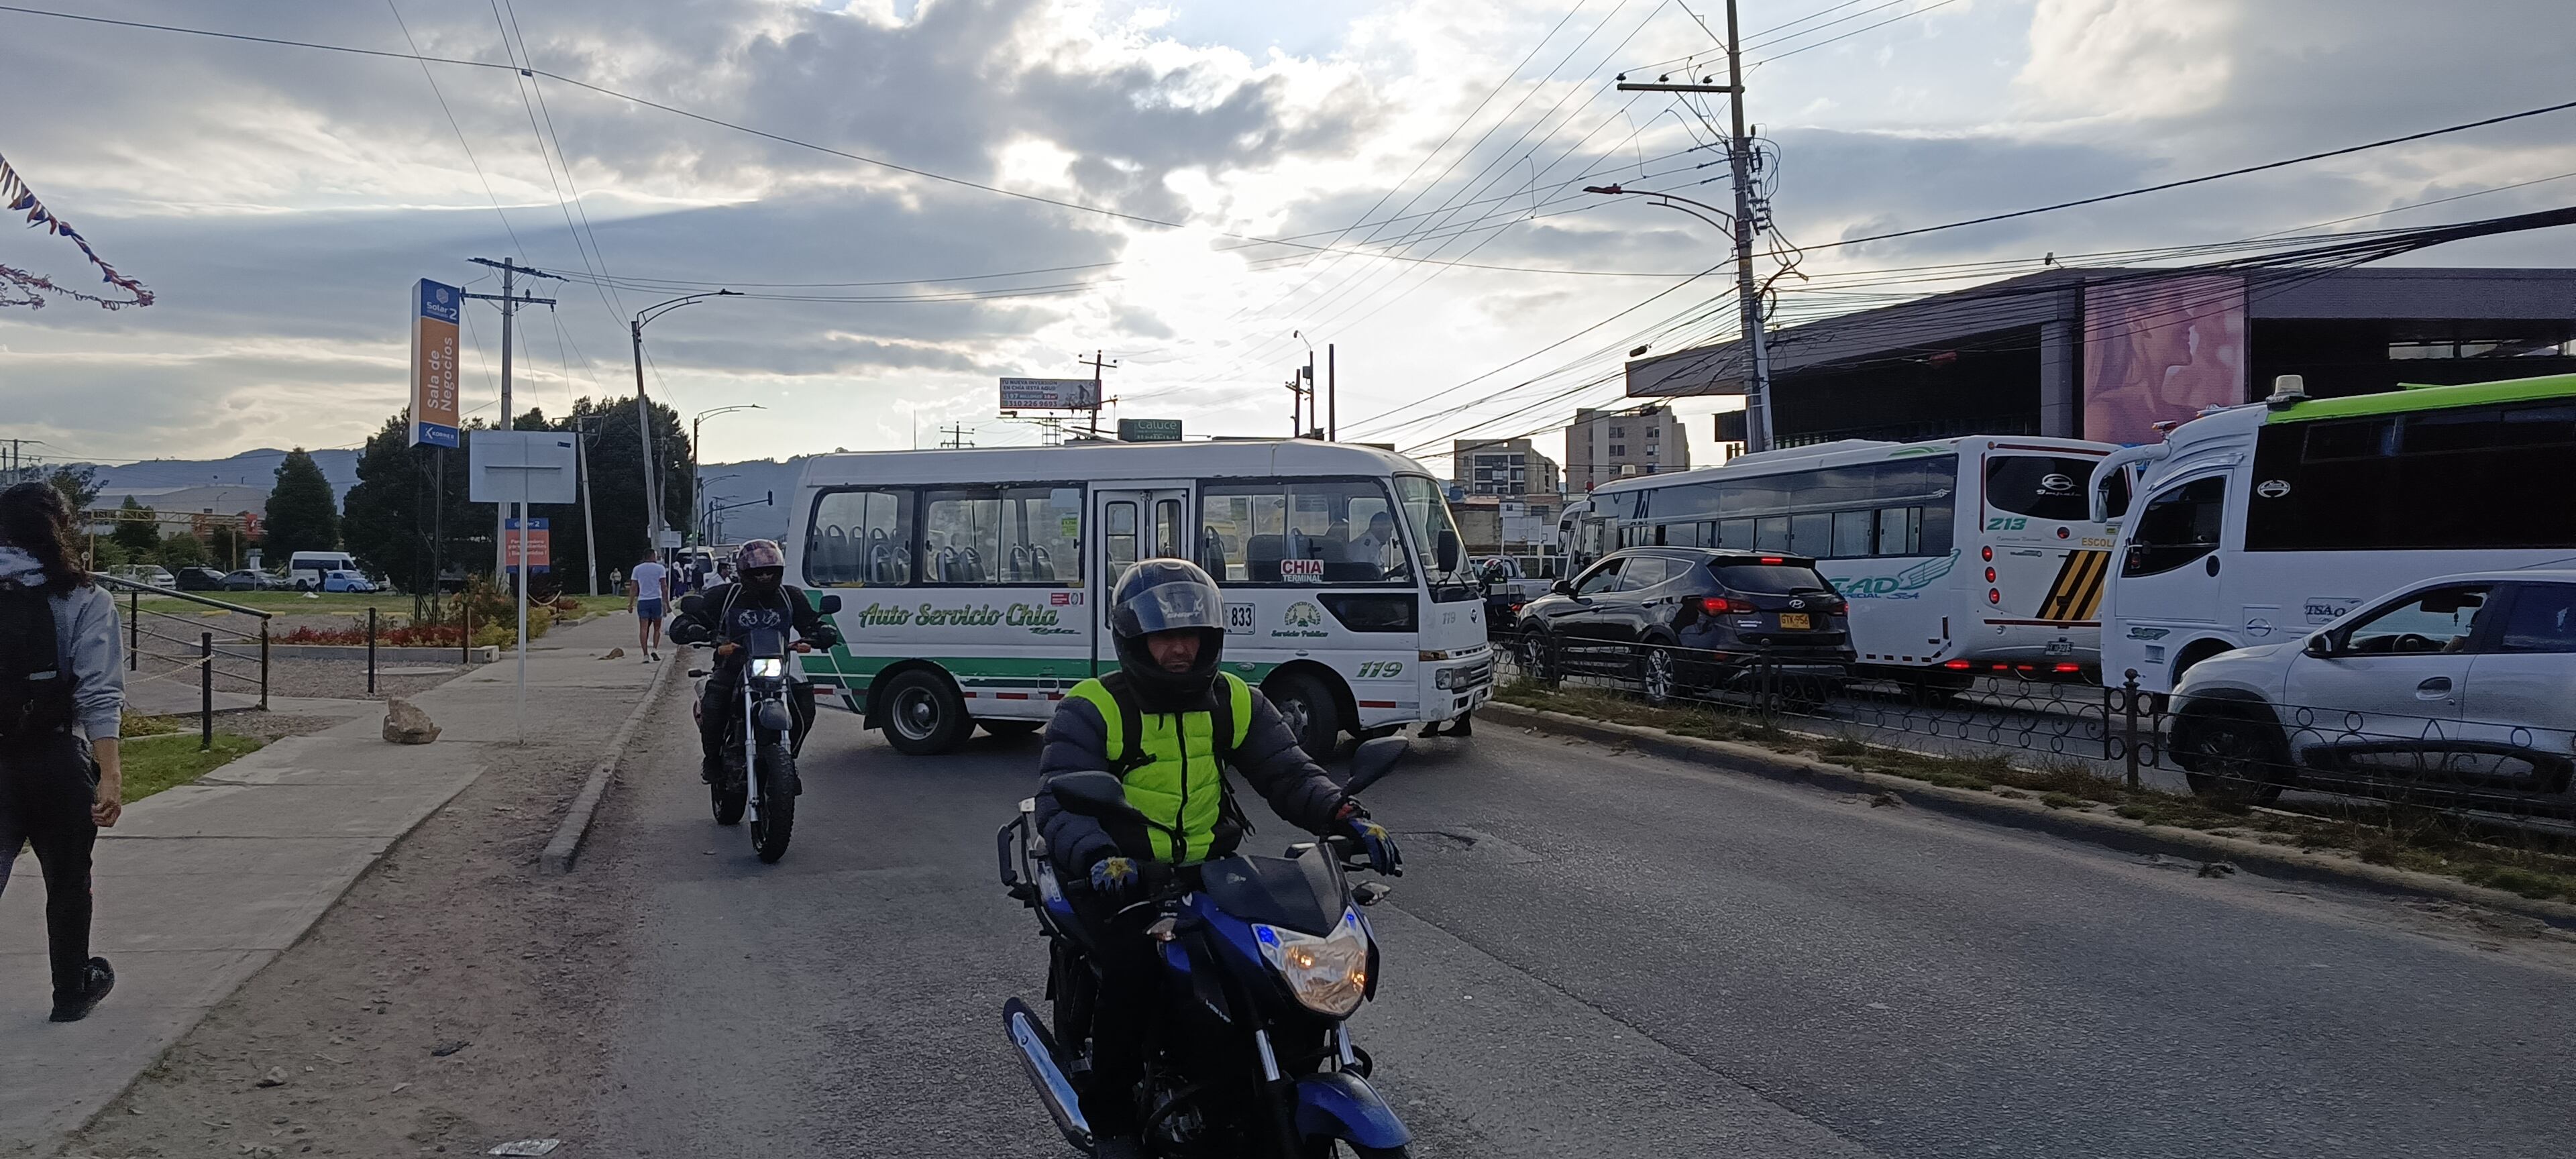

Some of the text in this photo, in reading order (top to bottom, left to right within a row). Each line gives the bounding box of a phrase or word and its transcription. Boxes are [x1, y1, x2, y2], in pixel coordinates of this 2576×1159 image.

[427, 301, 448, 313] Solar
[449, 308, 458, 320] 2
[427, 350, 439, 409] Sala de
[440, 337, 455, 412] Negocios
[1138, 421, 1177, 430] Caluce
[1986, 518, 2028, 531] 213
[2082, 537, 2114, 547] ESCOL
[1282, 561, 1322, 574] CHIA
[1282, 574, 1322, 582] TERMINAL
[859, 602, 1059, 628] Auto Servicio Chia
[1231, 607, 1252, 626] 833
[1442, 612, 1456, 624] 119
[1271, 629, 1300, 637] Servicio
[1356, 661, 1403, 677] 119
